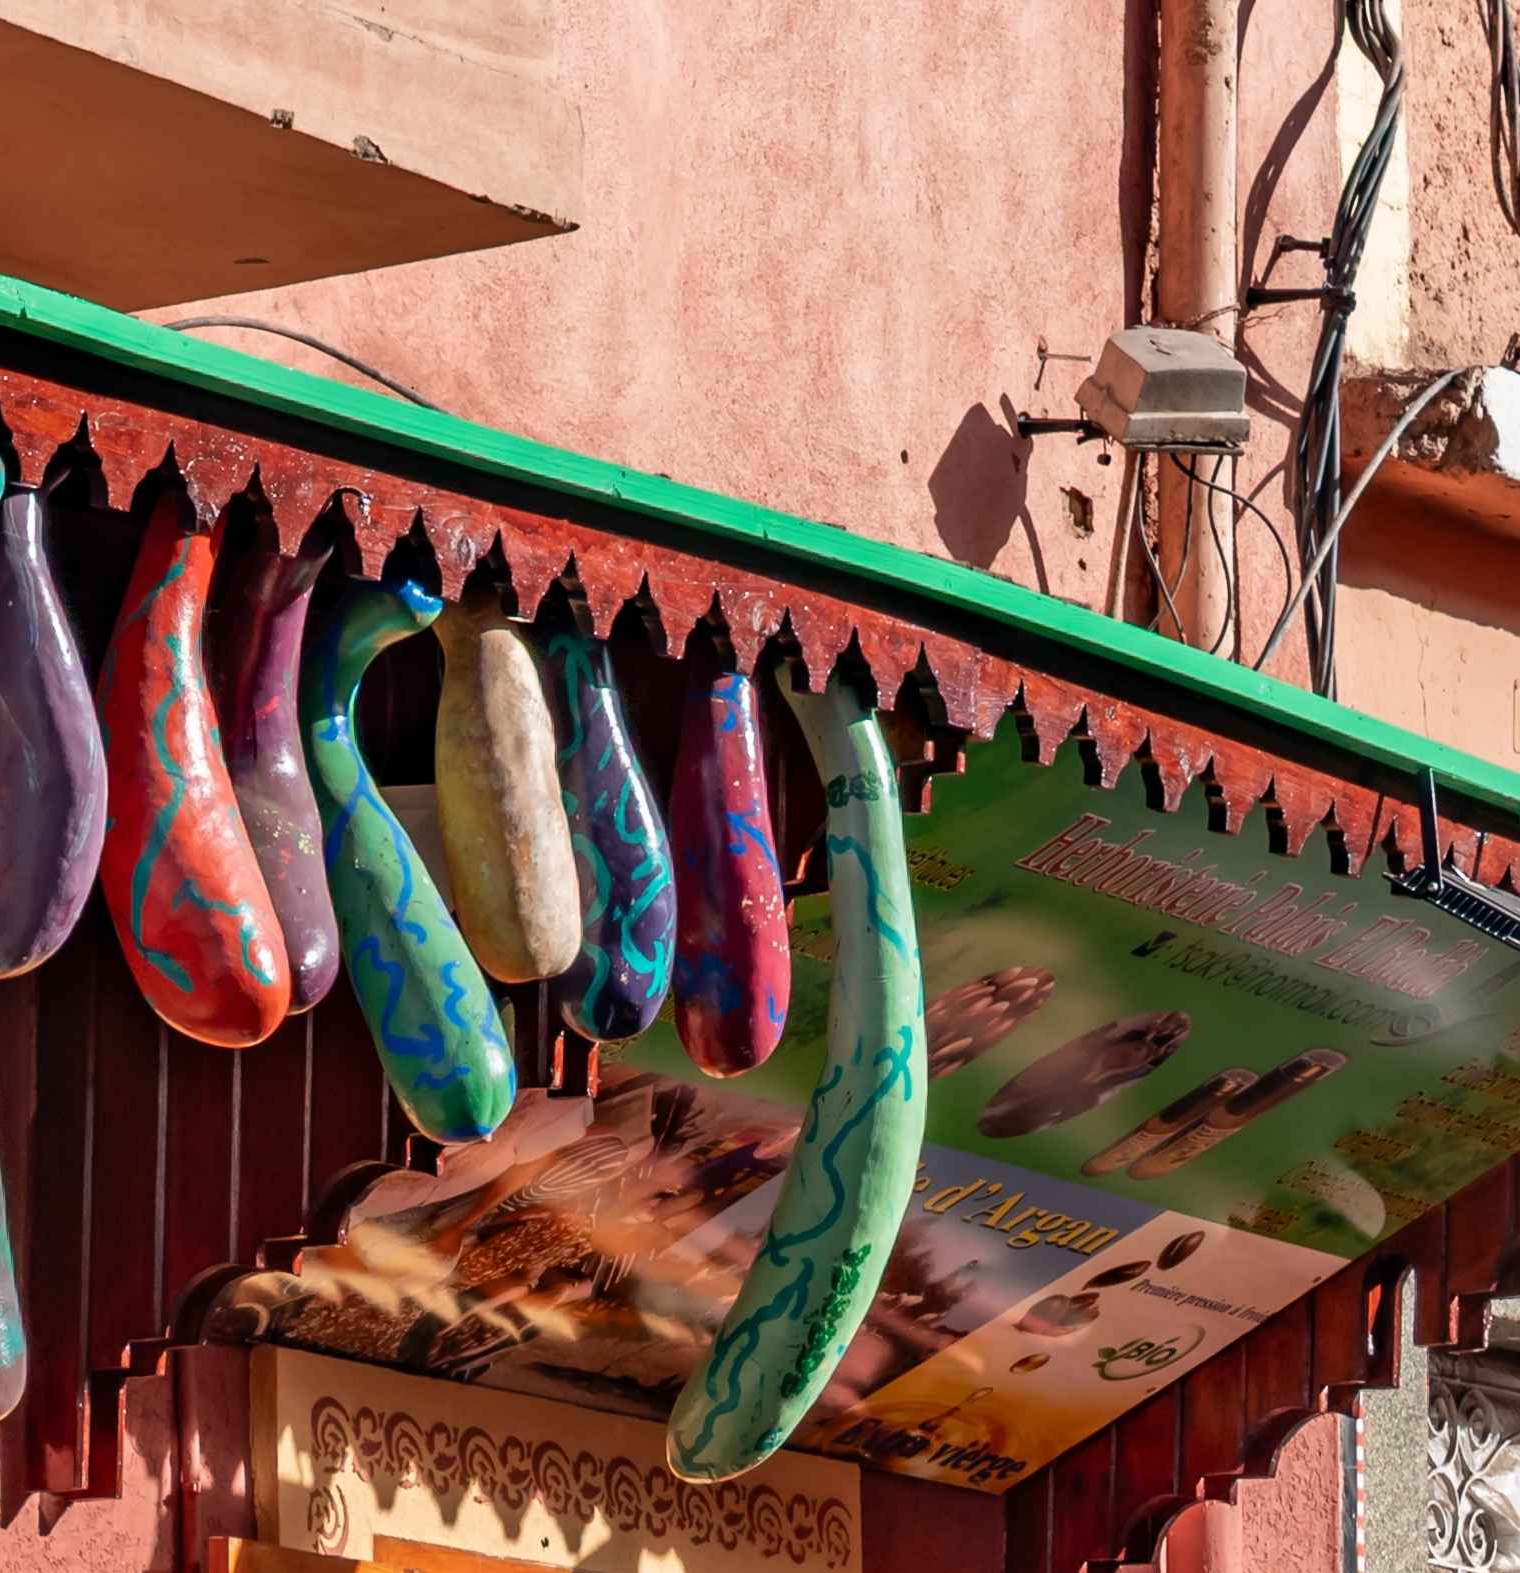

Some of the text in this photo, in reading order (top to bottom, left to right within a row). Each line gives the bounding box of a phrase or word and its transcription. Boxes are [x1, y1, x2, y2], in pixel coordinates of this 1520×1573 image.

[1217, 882, 1359, 956] Palais
[1312, 914, 1417, 972] El
[922, 1177, 1120, 1256] d'Argan
